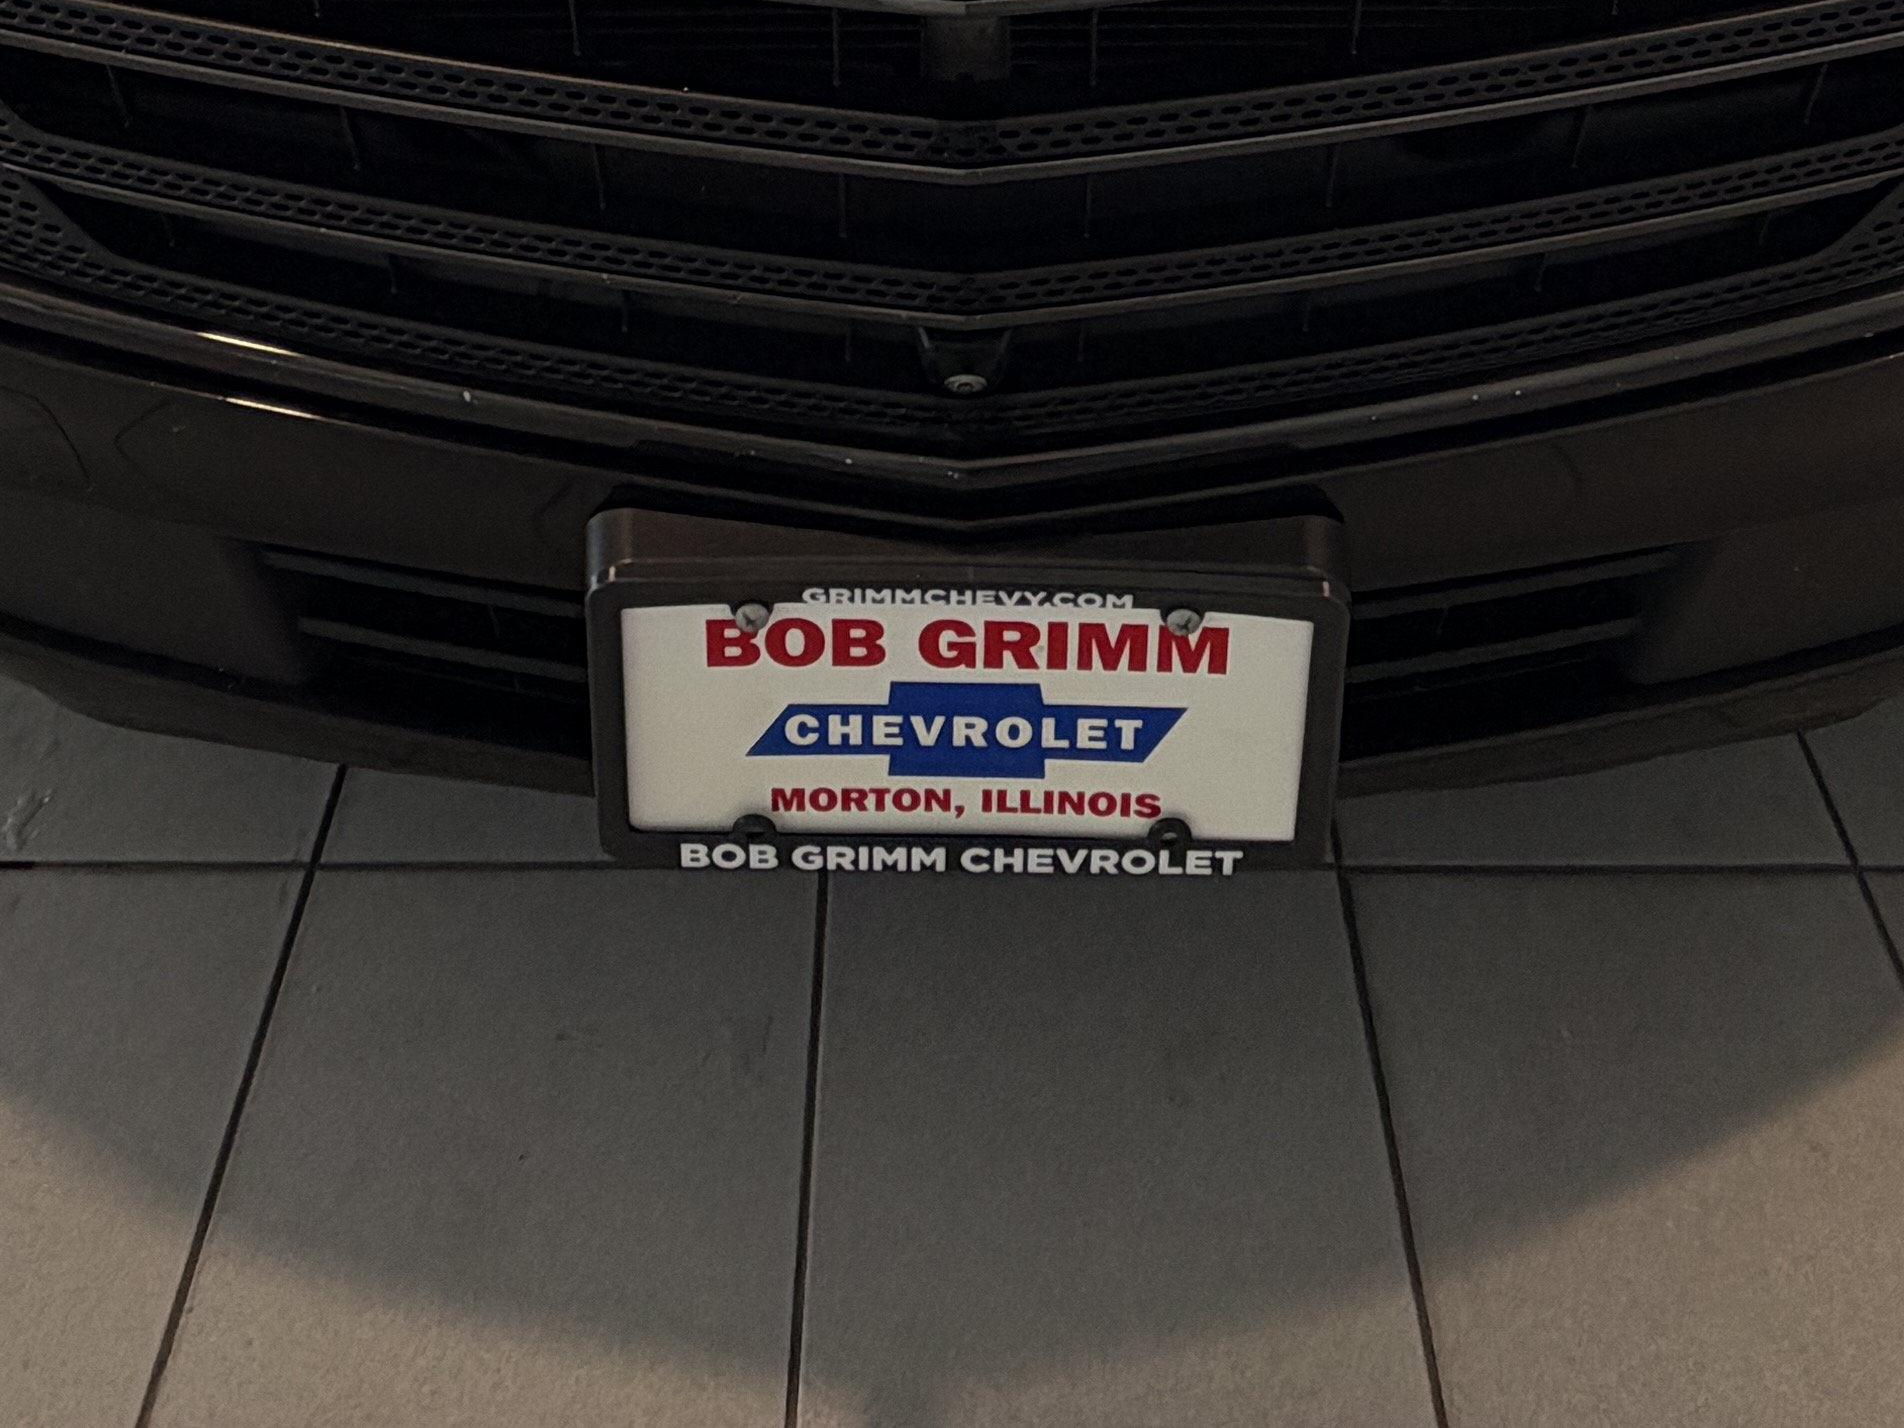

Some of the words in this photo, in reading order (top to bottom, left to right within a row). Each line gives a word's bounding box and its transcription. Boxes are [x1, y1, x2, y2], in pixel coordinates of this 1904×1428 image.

[800, 586, 1136, 610] GRIMMCHEVY.COM
[705, 616, 887, 669] BOB
[917, 618, 1231, 677] GRIMM
[783, 712, 1144, 751] CHEVROLET
[770, 786, 966, 820] MORTON,
[980, 787, 1163, 820] ILLINOIS
[679, 841, 780, 870] BOB
[790, 843, 947, 874] GRIMM
[959, 846, 1245, 877] CHEVROLET
